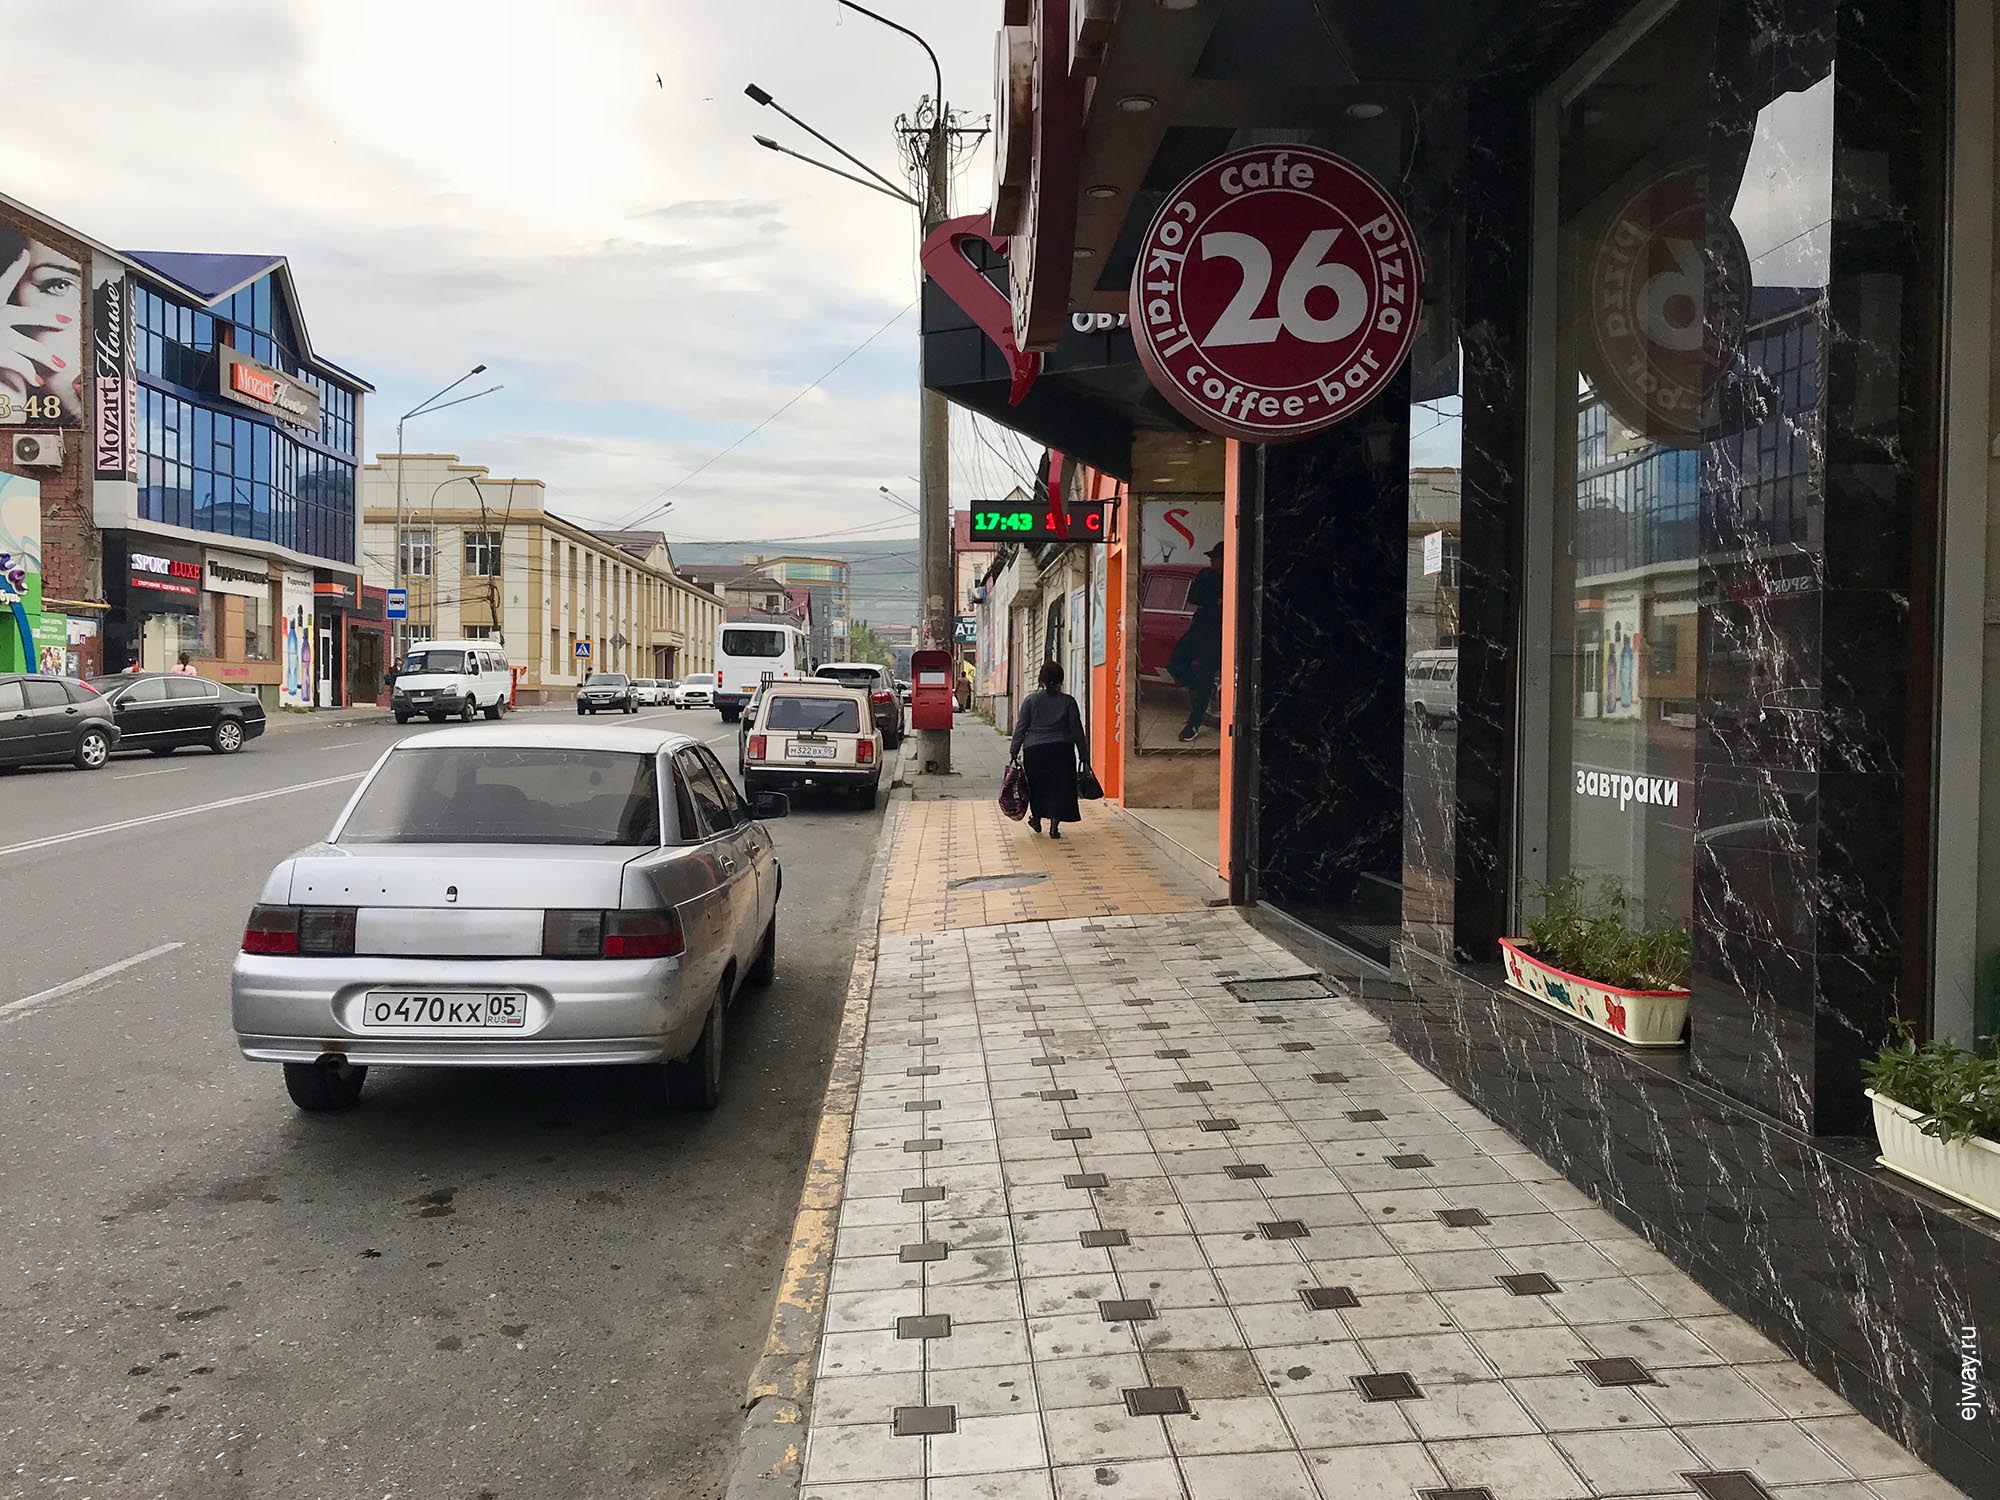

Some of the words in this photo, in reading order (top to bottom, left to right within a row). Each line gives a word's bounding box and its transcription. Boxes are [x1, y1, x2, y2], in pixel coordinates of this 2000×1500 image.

[1219, 153, 1315, 195] cafe
[1146, 200, 1197, 359] coktail
[1200, 228, 1369, 348] 26
[1359, 212, 1409, 334] pizza
[94, 283, 121, 380] House
[237, 364, 273, 400] Mozart
[272, 380, 308, 416] House
[1186, 347, 1381, 421] coffee-bar
[99, 378, 121, 469] Mozart
[974, 512, 1034, 531] 17:43
[131, 553, 171, 576] SPORT
[171, 560, 201, 580] LUXE
[207, 560, 269, 585] Tupperware
[1576, 770, 1679, 812] завтраки
[487, 1015, 507, 1024] RUS
[489, 996, 517, 1016] 05
